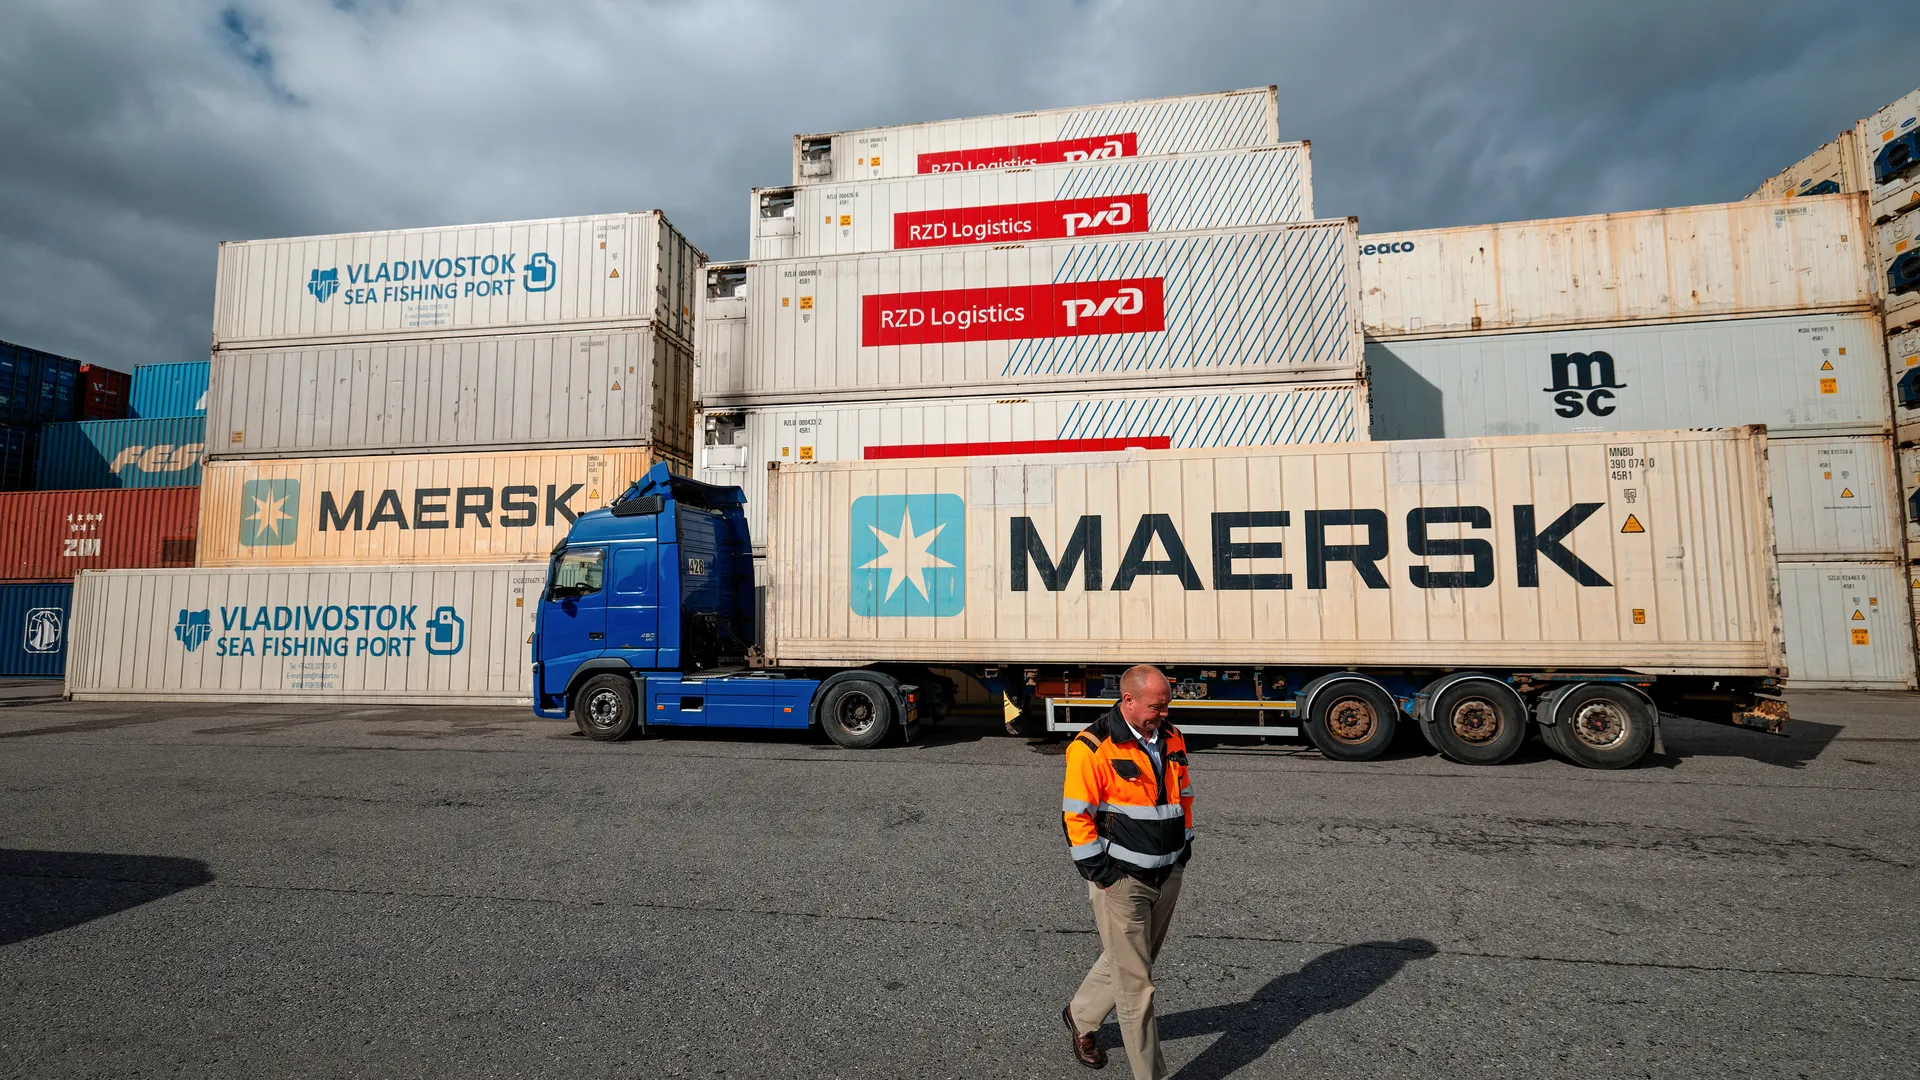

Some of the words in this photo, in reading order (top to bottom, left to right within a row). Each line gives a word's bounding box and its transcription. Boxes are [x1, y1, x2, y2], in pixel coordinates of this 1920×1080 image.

[910, 223, 947, 240] RZD
[952, 217, 1032, 240] Logistics
[346, 253, 516, 284] VLADIVOSTOK
[344, 288, 377, 305] SEA
[384, 282, 458, 303] FISHING
[464, 279, 516, 298] PORT
[881, 308, 925, 328] RZD
[931, 304, 1025, 330] Logistics
[109, 443, 204, 473] FES
[1609, 447, 1634, 457] MNBU
[1610, 459, 1626, 469] 390
[1629, 459, 1644, 468] 074
[1649, 458, 1654, 468] 0
[1611, 471, 1632, 480] 45R1
[318, 483, 585, 531] MAERSK
[64, 538, 100, 557] ZIM
[1010, 502, 1614, 591] MAERSK
[689, 560, 704, 574] 428
[220, 605, 417, 631] VLADIVOSTOK
[216, 637, 255, 657] SEA
[262, 636, 348, 657] FISHING
[356, 637, 416, 657] PORT
